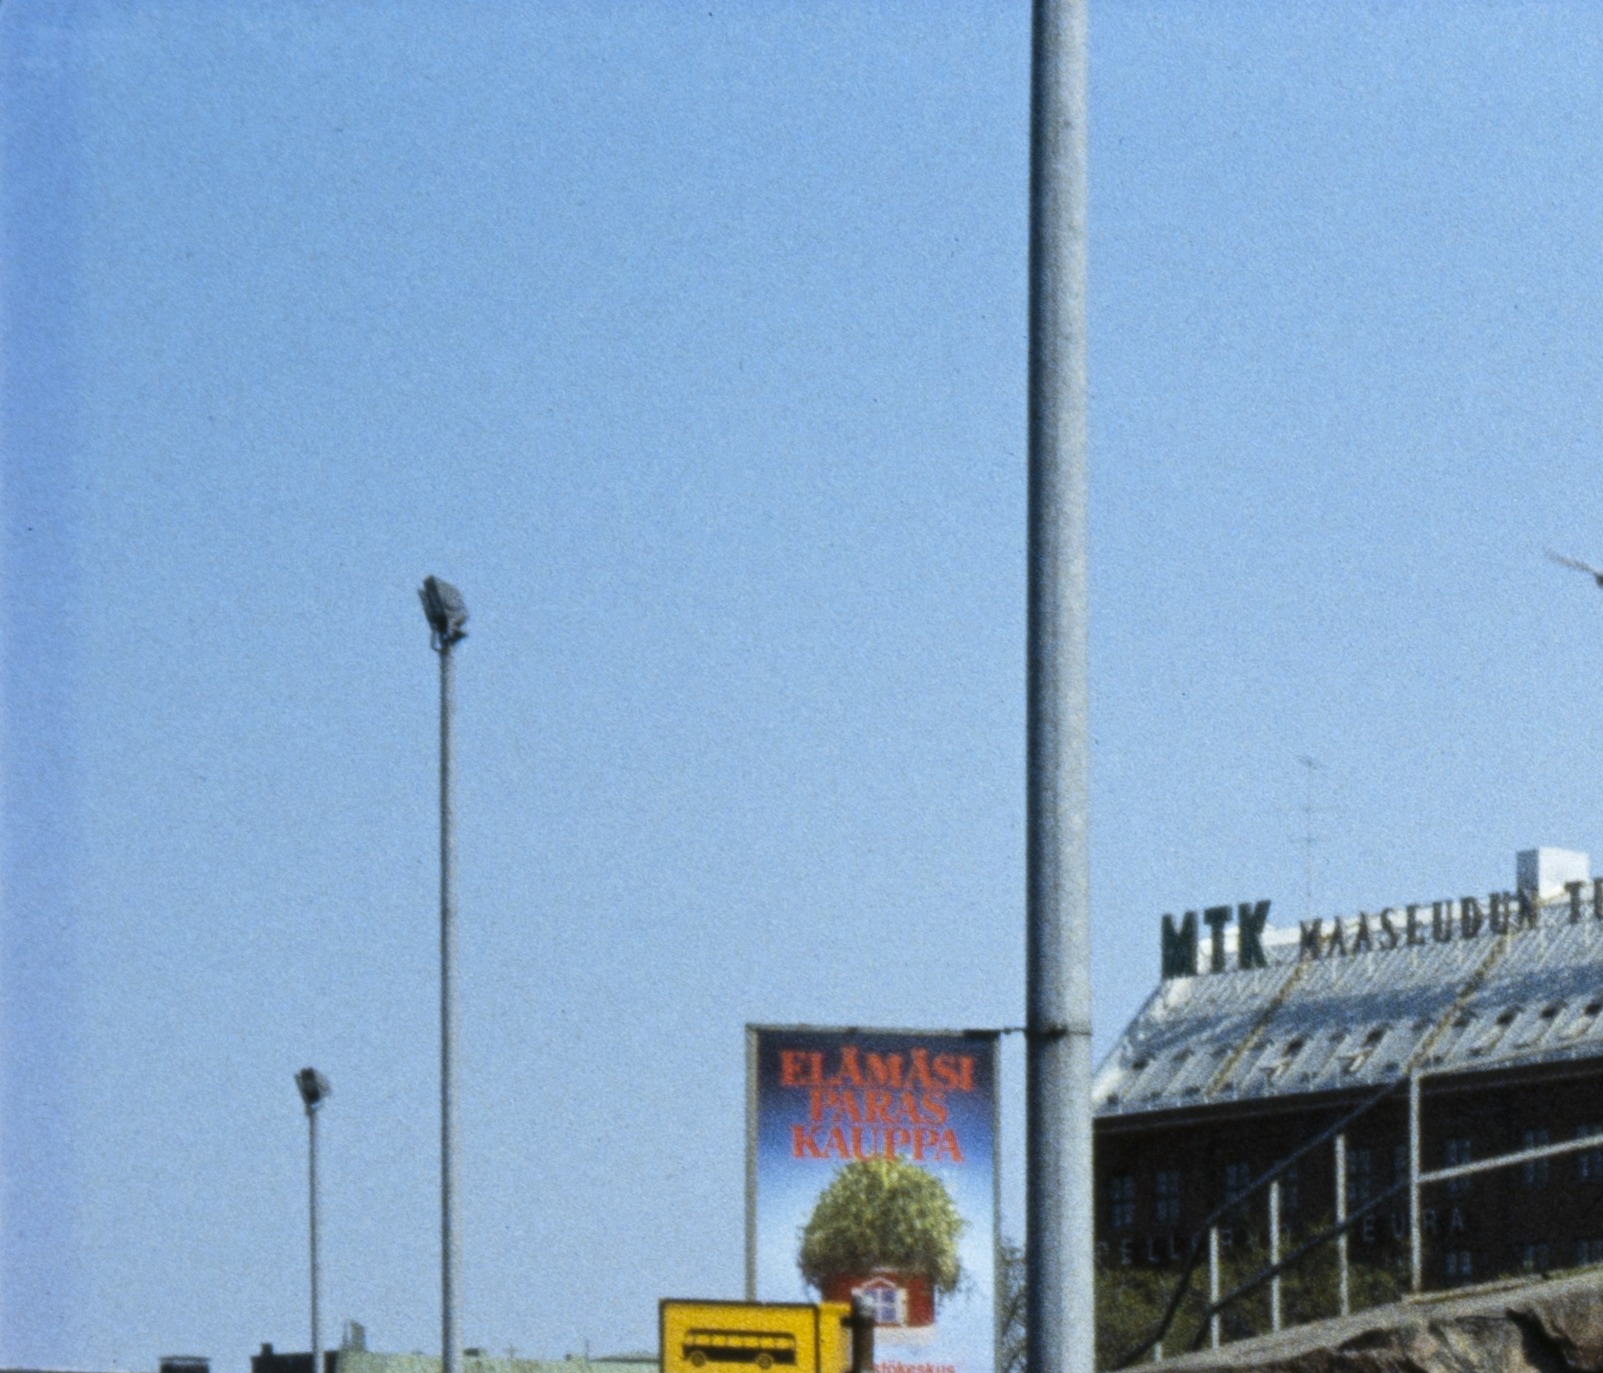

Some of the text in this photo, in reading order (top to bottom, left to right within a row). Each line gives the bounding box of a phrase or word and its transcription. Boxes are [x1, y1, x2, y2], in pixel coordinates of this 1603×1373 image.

[1161, 899, 1271, 979] MTK
[1299, 884, 1540, 961] MAASEUDUN
[780, 1045, 975, 1092] ELÄMÄSI
[809, 1086, 948, 1126] PARAS
[790, 1123, 964, 1163] KAUPPA
